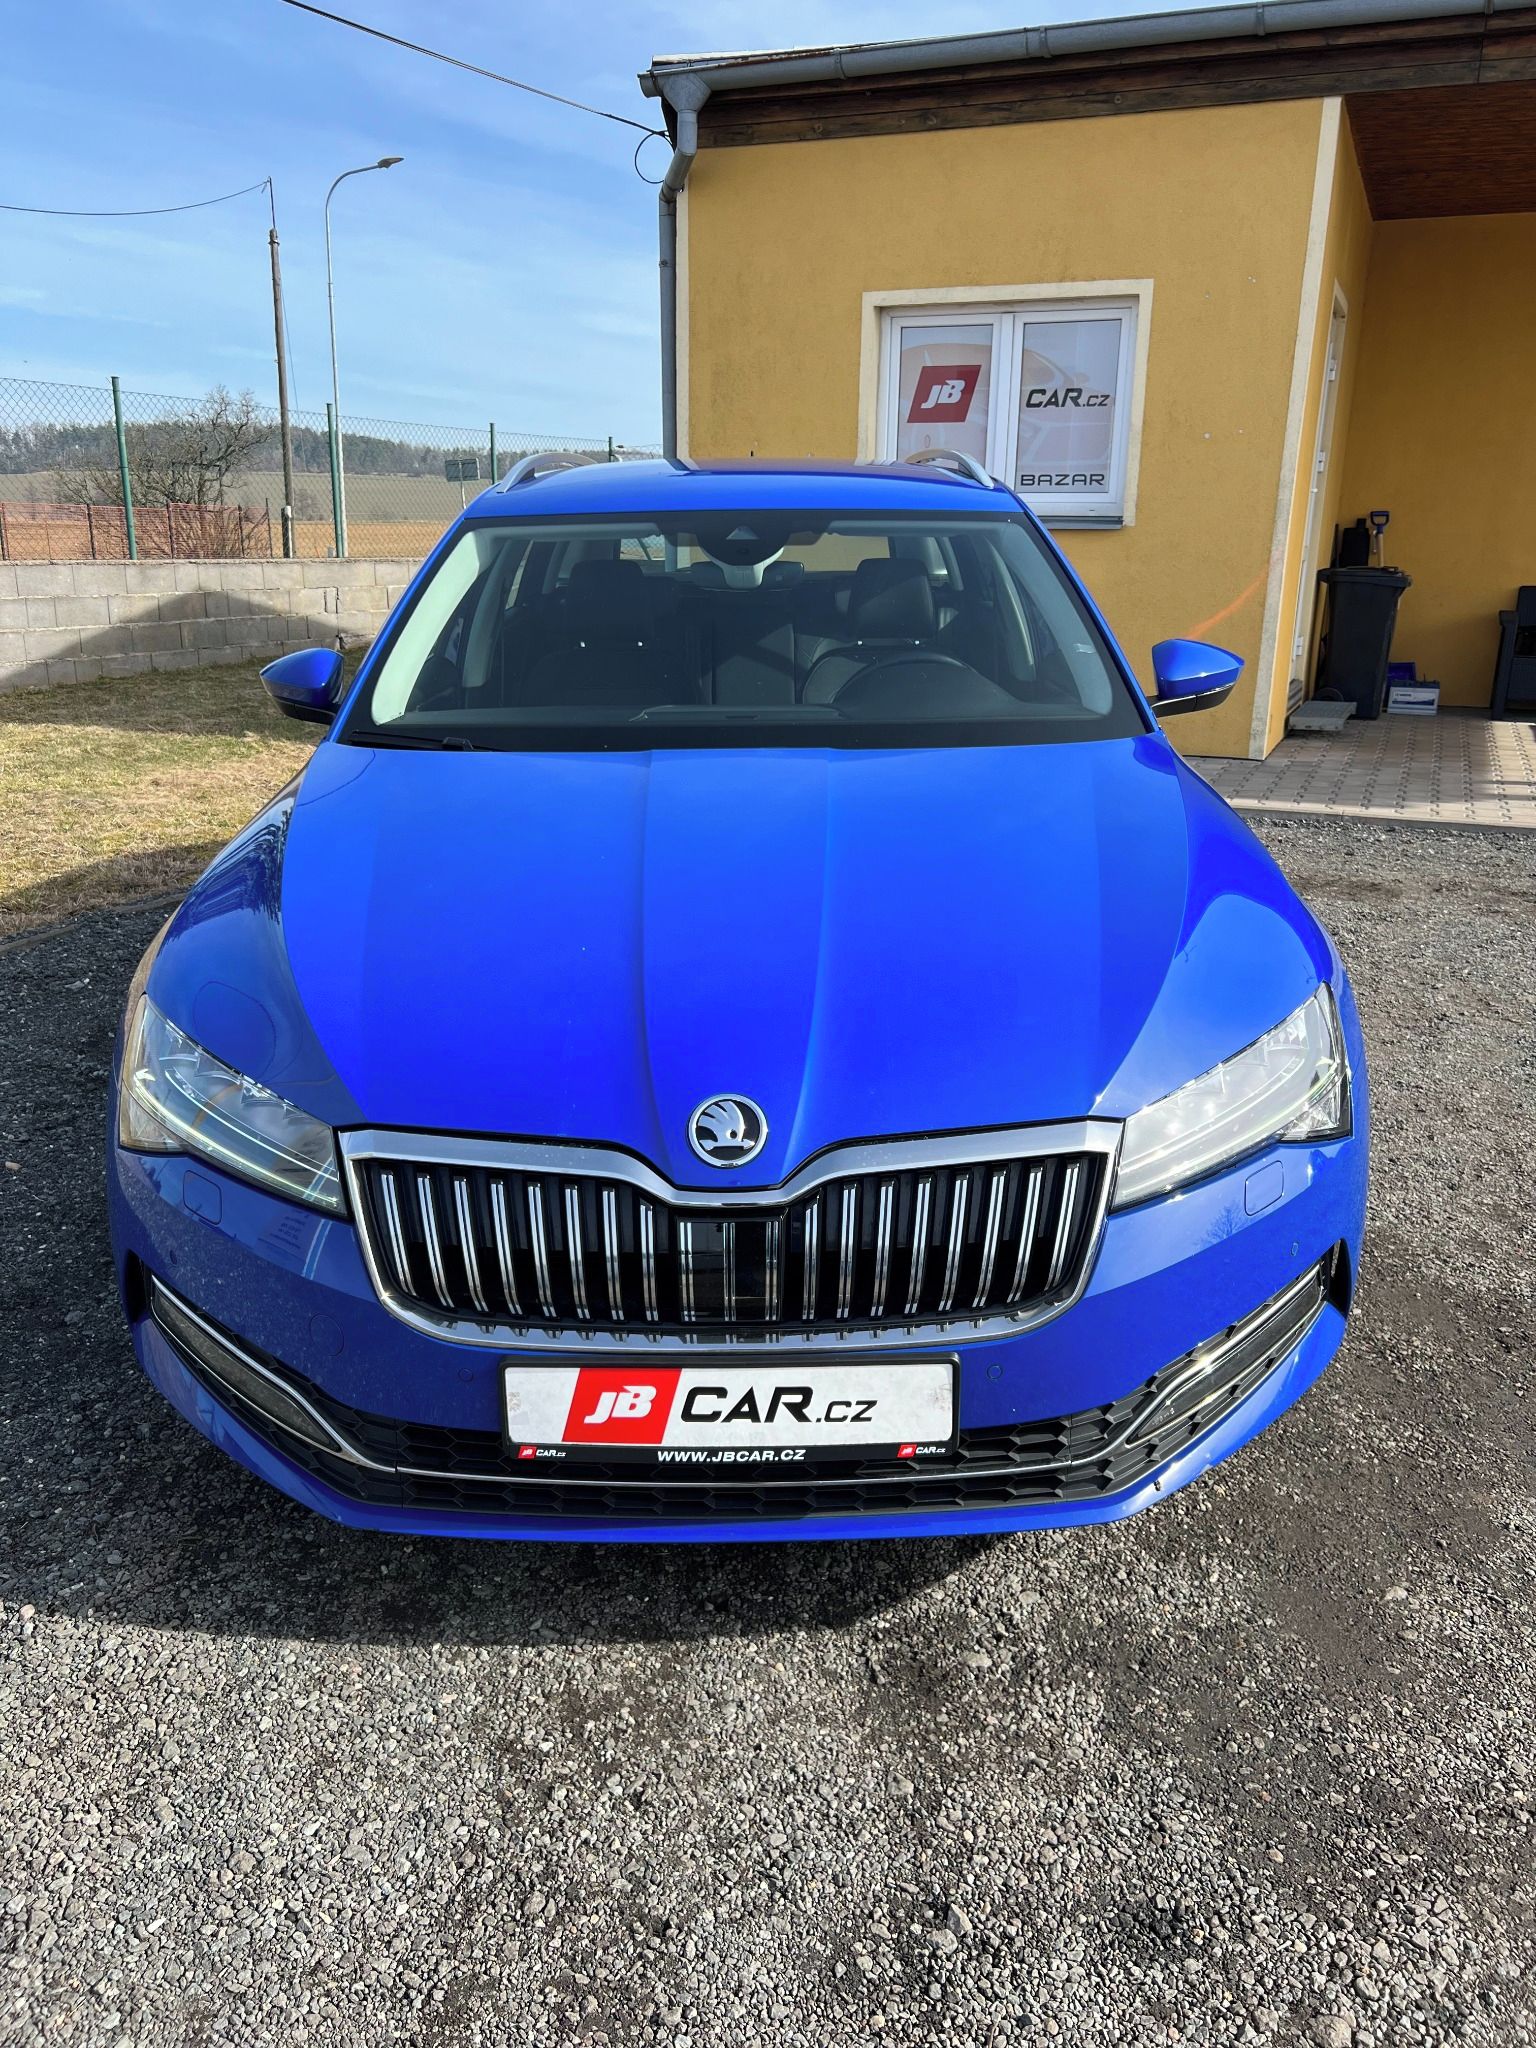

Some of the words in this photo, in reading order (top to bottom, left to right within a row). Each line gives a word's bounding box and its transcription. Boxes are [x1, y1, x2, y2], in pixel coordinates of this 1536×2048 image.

[920, 379, 966, 409] JB
[1020, 473, 1105, 486] BAZAR
[583, 1385, 657, 1424] JB
[657, 1449, 807, 1462] WWW.JBCAR.CZ
